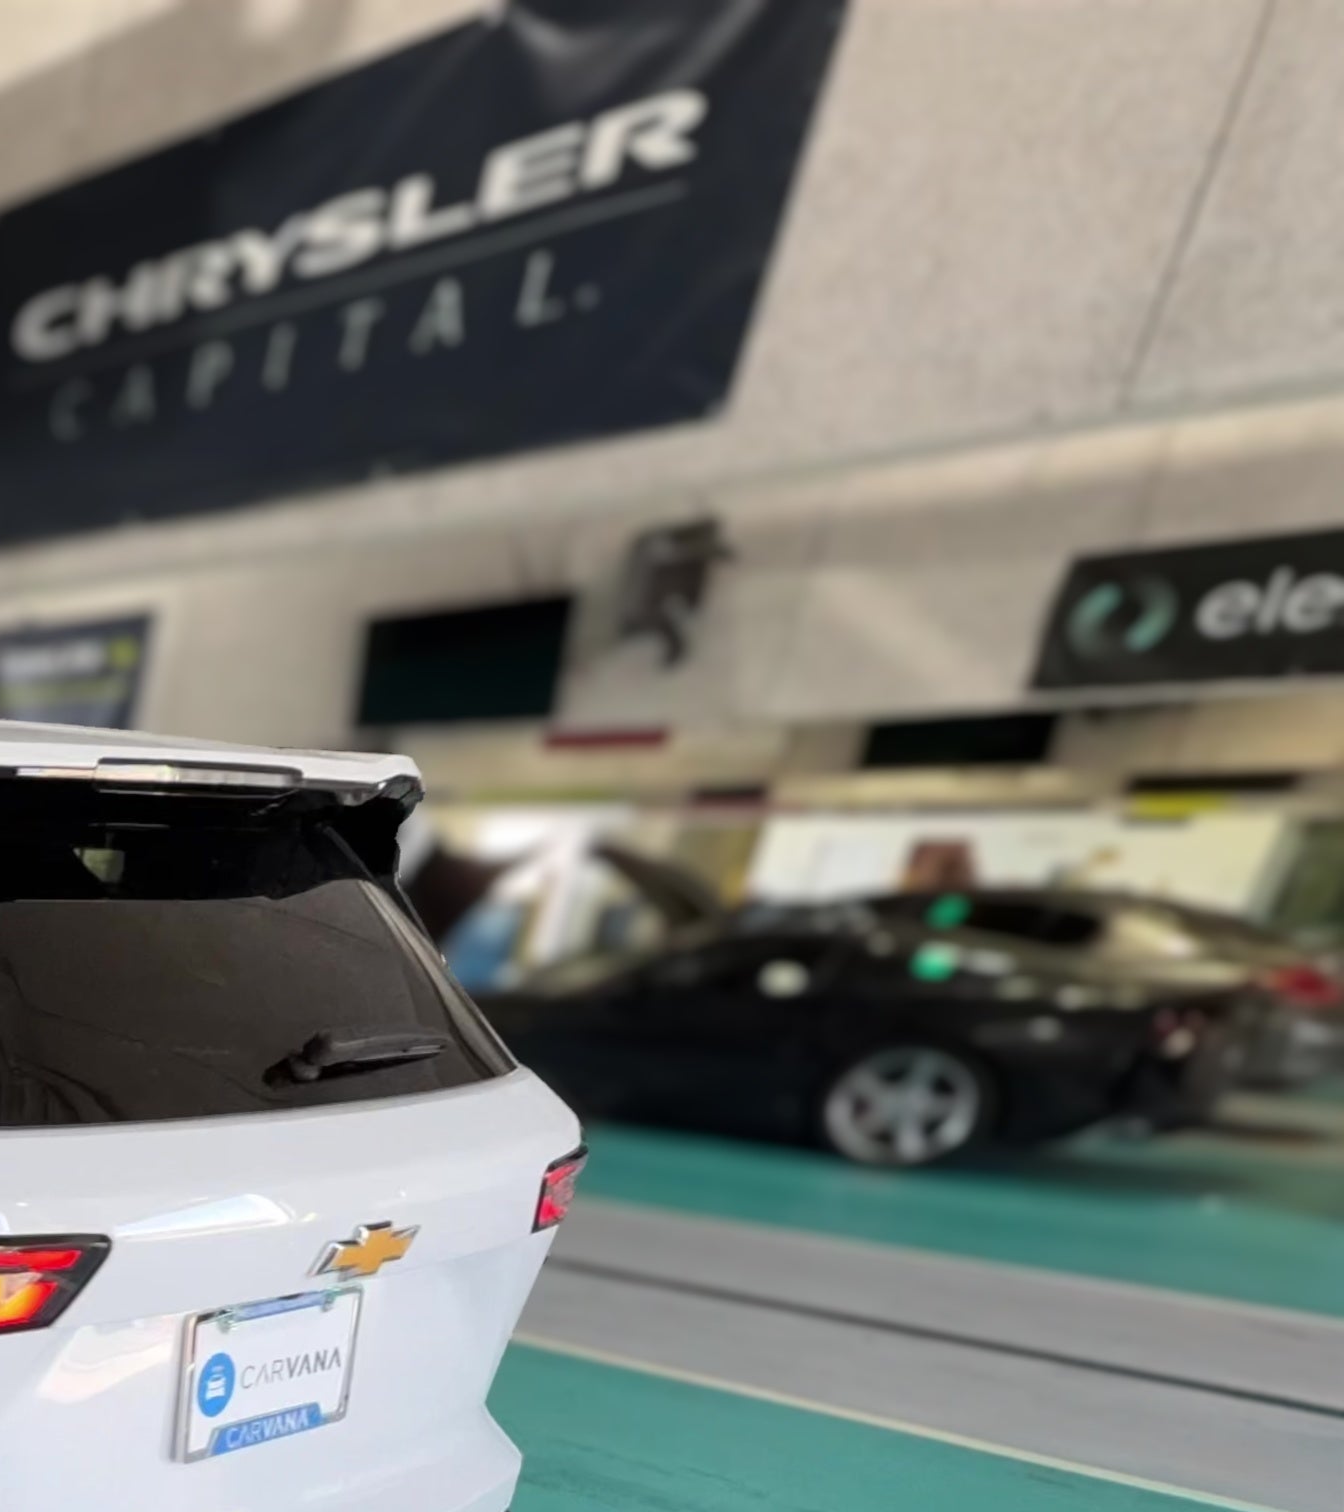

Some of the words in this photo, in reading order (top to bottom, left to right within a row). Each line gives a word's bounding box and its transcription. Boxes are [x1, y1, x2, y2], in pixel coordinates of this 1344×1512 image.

[11, 88, 708, 362] CHRYSLER
[240, 1347, 341, 1389] CARVANA
[226, 1408, 309, 1448] CARVANA
